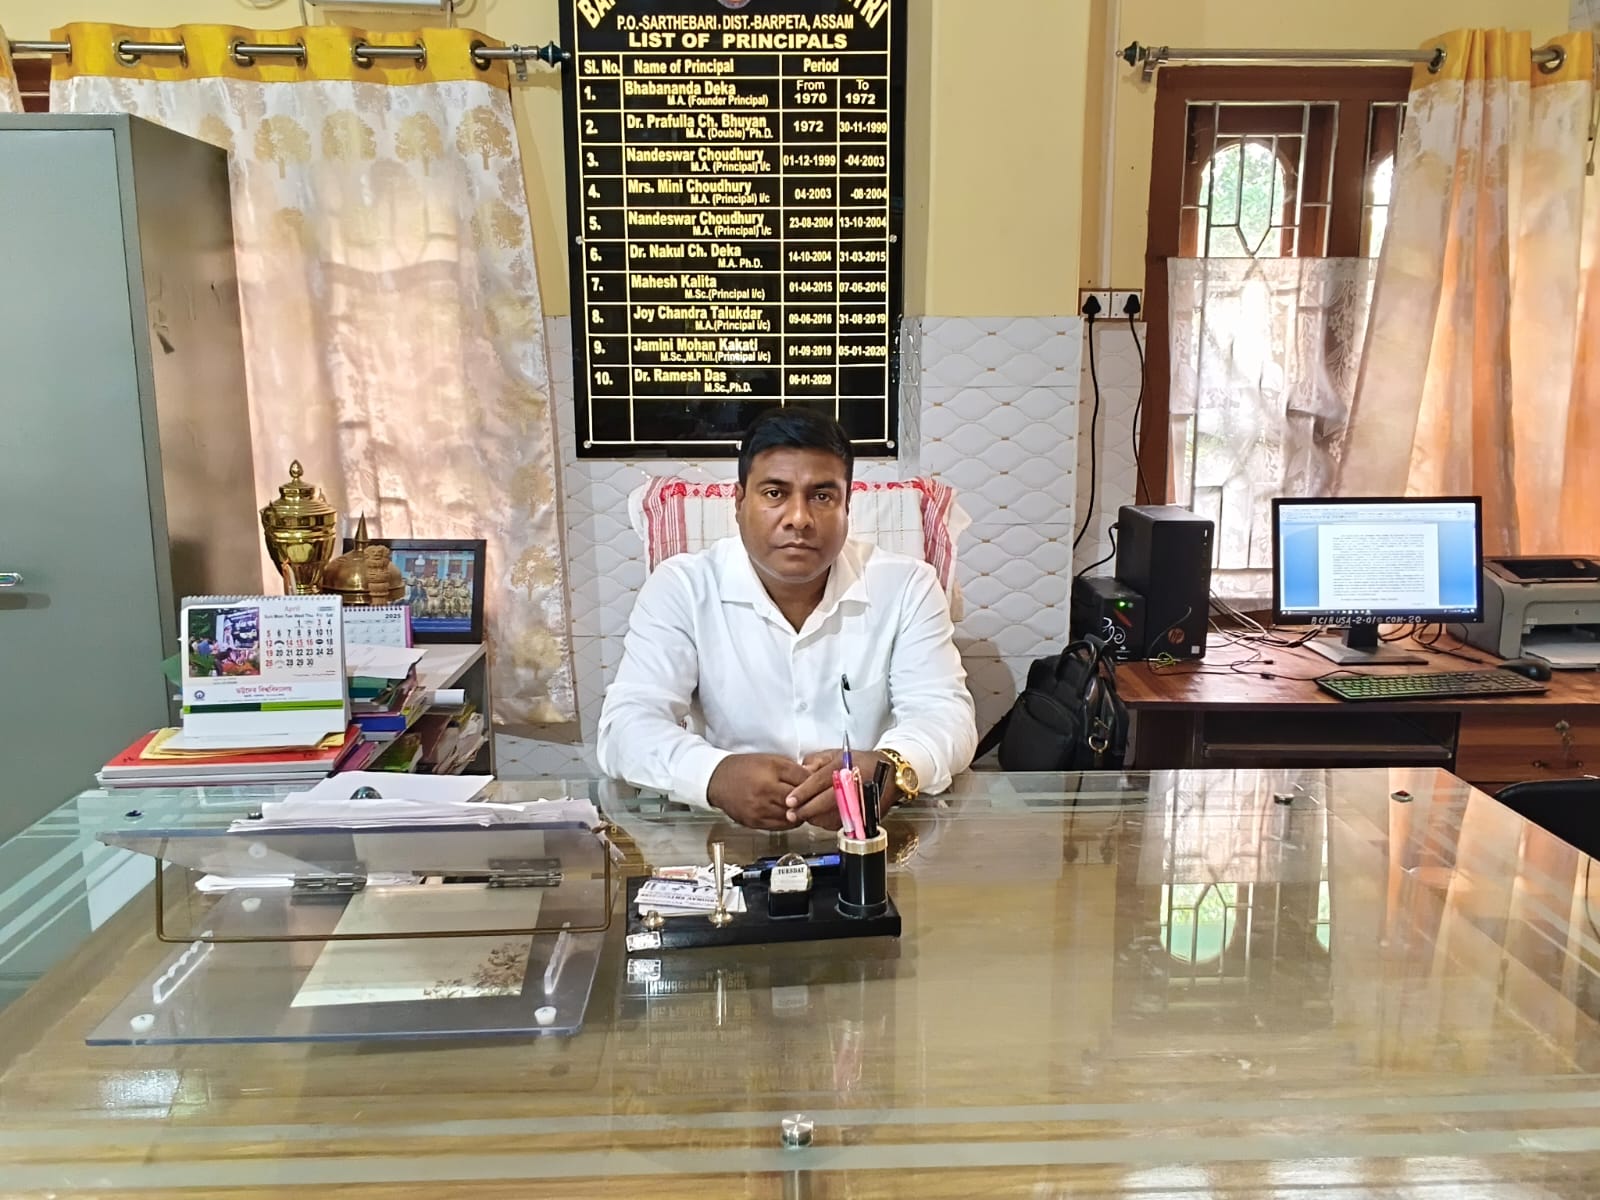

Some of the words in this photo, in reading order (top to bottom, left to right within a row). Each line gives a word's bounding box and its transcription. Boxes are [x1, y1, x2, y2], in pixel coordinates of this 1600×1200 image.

[812, 14, 854, 30] ASSAM
[628, 32, 676, 48] LIST
[681, 33, 710, 48] OF
[722, 33, 848, 49] PRINCIPALS
[633, 59, 667, 74] Name
[669, 58, 682, 74] of
[684, 58, 735, 76] Principal
[803, 57, 840, 73] Period
[624, 80, 702, 96] Bhabananda
[704, 80, 736, 96] Deka
[796, 79, 825, 91] From
[855, 79, 870, 91] To
[583, 85, 597, 101] 1.
[794, 92, 828, 105] 1970
[844, 92, 876, 105] 1972
[667, 95, 687, 106] M.A.
[688, 95, 727, 108] (Founder
[728, 95, 769, 107] Principal)
[585, 119, 599, 135] 2.
[626, 114, 644, 129] Dr.
[646, 114, 695, 129] Prafulla
[697, 114, 718, 129] Ch.
[721, 114, 767, 131] Bhuyan
[793, 120, 824, 133] 1972
[839, 121, 888, 134] 30-11-1999
[685, 127, 706, 139] M.A.
[707, 127, 746, 140] (Double)
[749, 127, 774, 139] Ph.D.
[586, 152, 600, 168] 3.
[626, 147, 696, 162] Nandeswar
[697, 147, 764, 164] Choudhury
[783, 154, 836, 167] 01-12-1999
[690, 161, 711, 172] M.A.
[712, 161, 759, 173] (Principal)
[587, 184, 601, 199] 4.
[627, 179, 655, 194] Mrs.
[657, 178, 684, 193] Mini
[686, 178, 752, 196] Choudhury
[690, 194, 711, 205] M.A.
[712, 193, 757, 206] (Principal)
[794, 188, 832, 200] 04-2003
[588, 215, 602, 231] 5.
[628, 210, 697, 226] Nandeswar
[699, 210, 765, 227] Choudhury
[789, 216, 834, 229] 23-08-2004
[839, 216, 887, 228] 13-10-2004
[692, 225, 713, 237] M.A.
[714, 225, 759, 237] (Principal)
[589, 247, 603, 262] 6.
[629, 243, 647, 259] Dr.
[649, 243, 685, 258] Nakul
[687, 243, 708, 258] Ch.
[710, 242, 742, 257] Deka
[788, 250, 832, 263] 14-10-2004
[839, 250, 887, 263] 31-03-2015
[717, 257, 738, 269] M.A.
[739, 257, 763, 269] Ph.D.
[590, 277, 604, 292] 7.
[630, 274, 678, 289] Mahesh
[680, 274, 717, 288] Kalita
[788, 281, 833, 293] 01-04-2015
[839, 281, 887, 294] 07-06-2016
[591, 309, 605, 324] 8.
[633, 306, 655, 323] Joy
[657, 305, 708, 321] Chandra
[710, 305, 763, 321] Talukdar
[788, 313, 833, 325] 09-06-2016
[839, 313, 887, 325] 31-08-2019
[593, 340, 606, 355] 9.
[633, 337, 674, 352] Jamini
[676, 337, 717, 352] Mohan
[718, 337, 758, 352] Kakati
[788, 345, 833, 357] 01-09-2019
[594, 371, 614, 386] 10.
[634, 368, 651, 383] Dr.
[653, 367, 702, 383] Ramesh
[703, 367, 727, 383] Das
[788, 374, 832, 385] 06-01-2020
[315, 628, 324, 636] 10
[326, 628, 334, 636] 11
[275, 649, 284, 657] 20
[285, 649, 294, 657] 21
[295, 648, 304, 656] 22
[305, 648, 314, 656] 23
[315, 648, 324, 656] 24
[326, 648, 334, 656] 25
[296, 658, 304, 667] 29
[306, 658, 314, 667] 30
